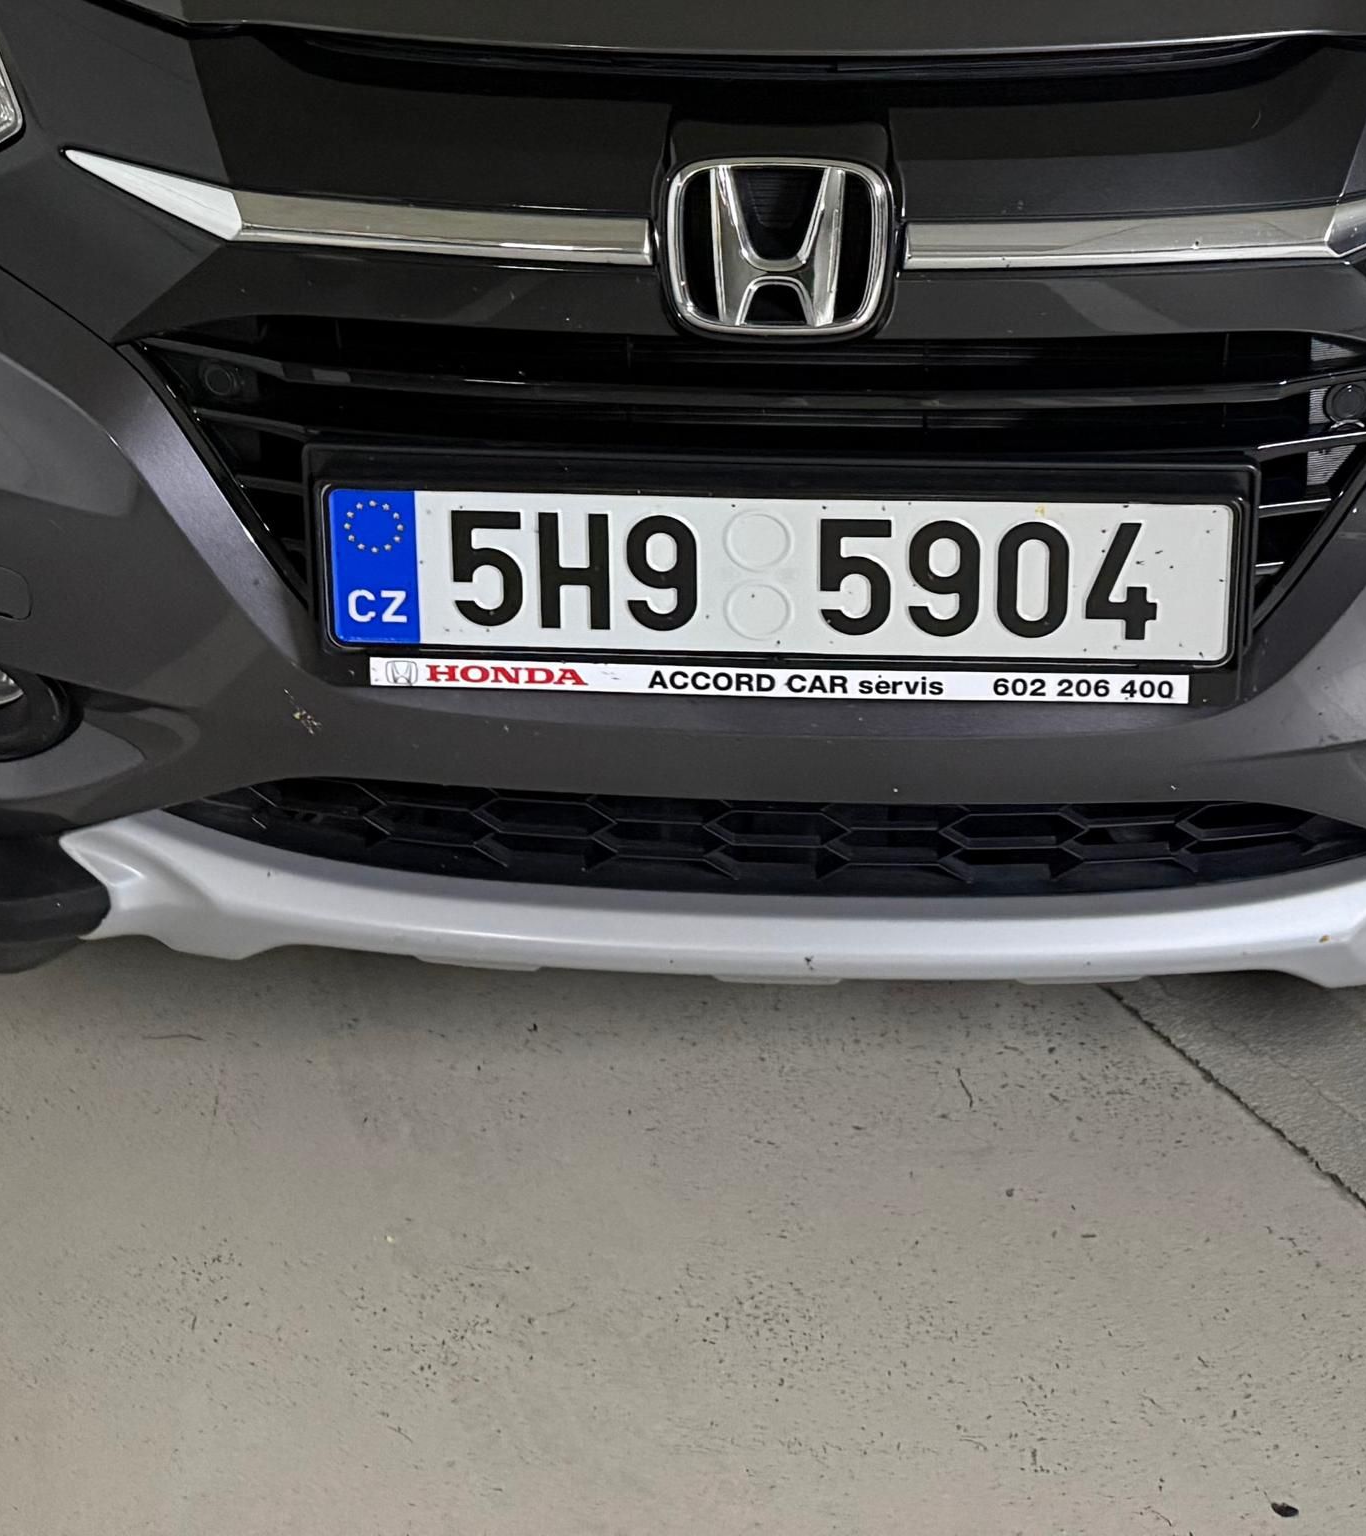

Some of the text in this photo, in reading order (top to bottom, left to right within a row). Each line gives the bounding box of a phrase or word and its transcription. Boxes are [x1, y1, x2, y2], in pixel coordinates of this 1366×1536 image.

[450, 508, 1158, 641] 5H9 5904
[347, 589, 408, 624] CZ
[425, 663, 1175, 700] HONDA ACCORD CAR servis 602 206 400
